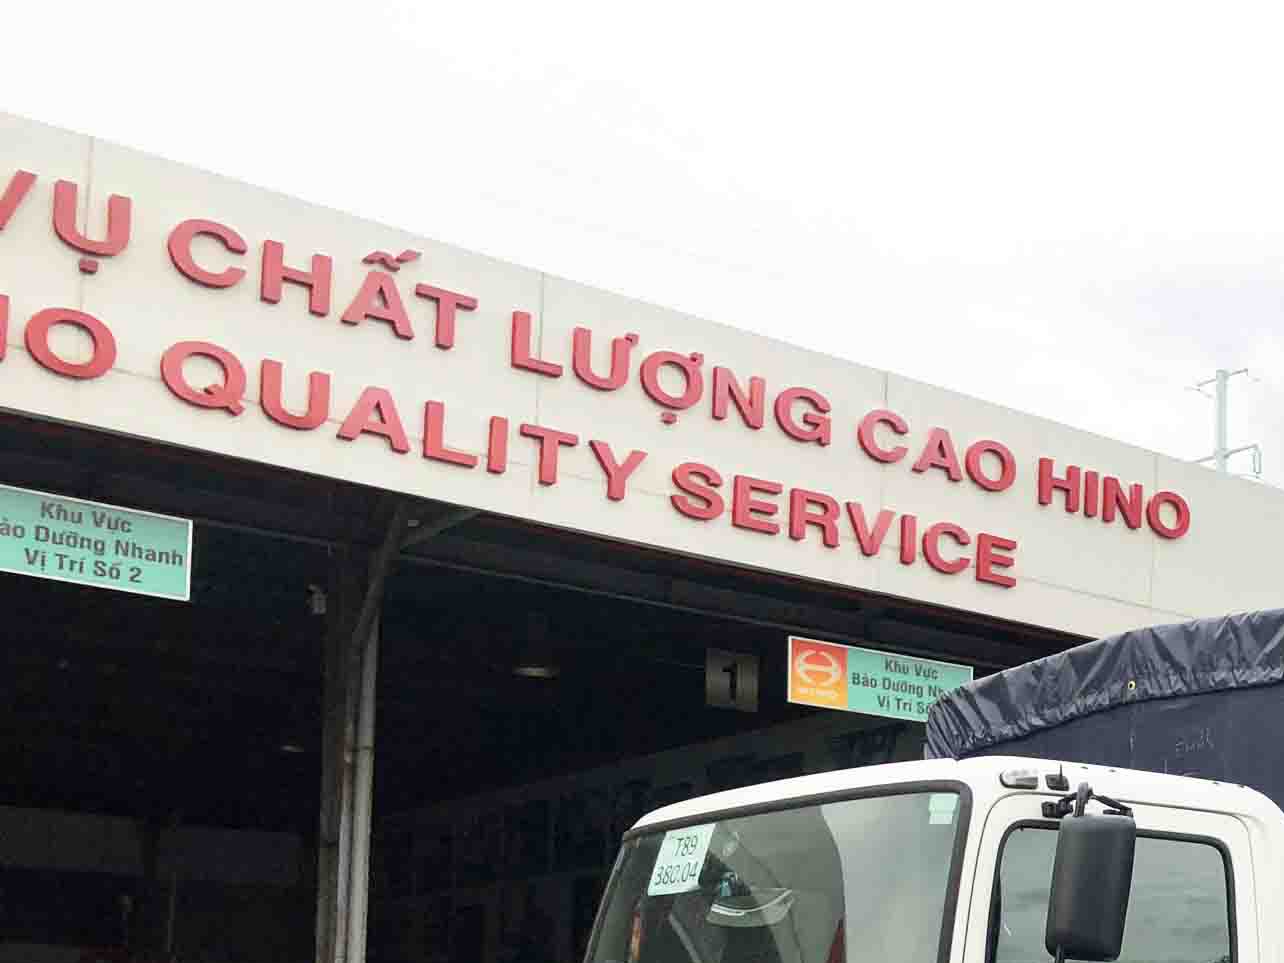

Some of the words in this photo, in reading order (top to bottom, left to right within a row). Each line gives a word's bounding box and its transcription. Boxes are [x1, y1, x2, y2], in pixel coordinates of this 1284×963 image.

[166, 219, 478, 351] CHẤT
[511, 311, 832, 448] LƯỢNG
[857, 410, 1017, 493] CAO
[1037, 457, 1191, 540] HINO
[0, 293, 118, 380] O
[160, 341, 648, 502] QUALITY
[670, 462, 1018, 589] SERVICE
[40, 501, 83, 524] Khu
[24, 547, 47, 572] Vị
[128, 566, 143, 584] 2
[114, 540, 184, 567] Nhanh
[884, 657, 909, 676] Khu
